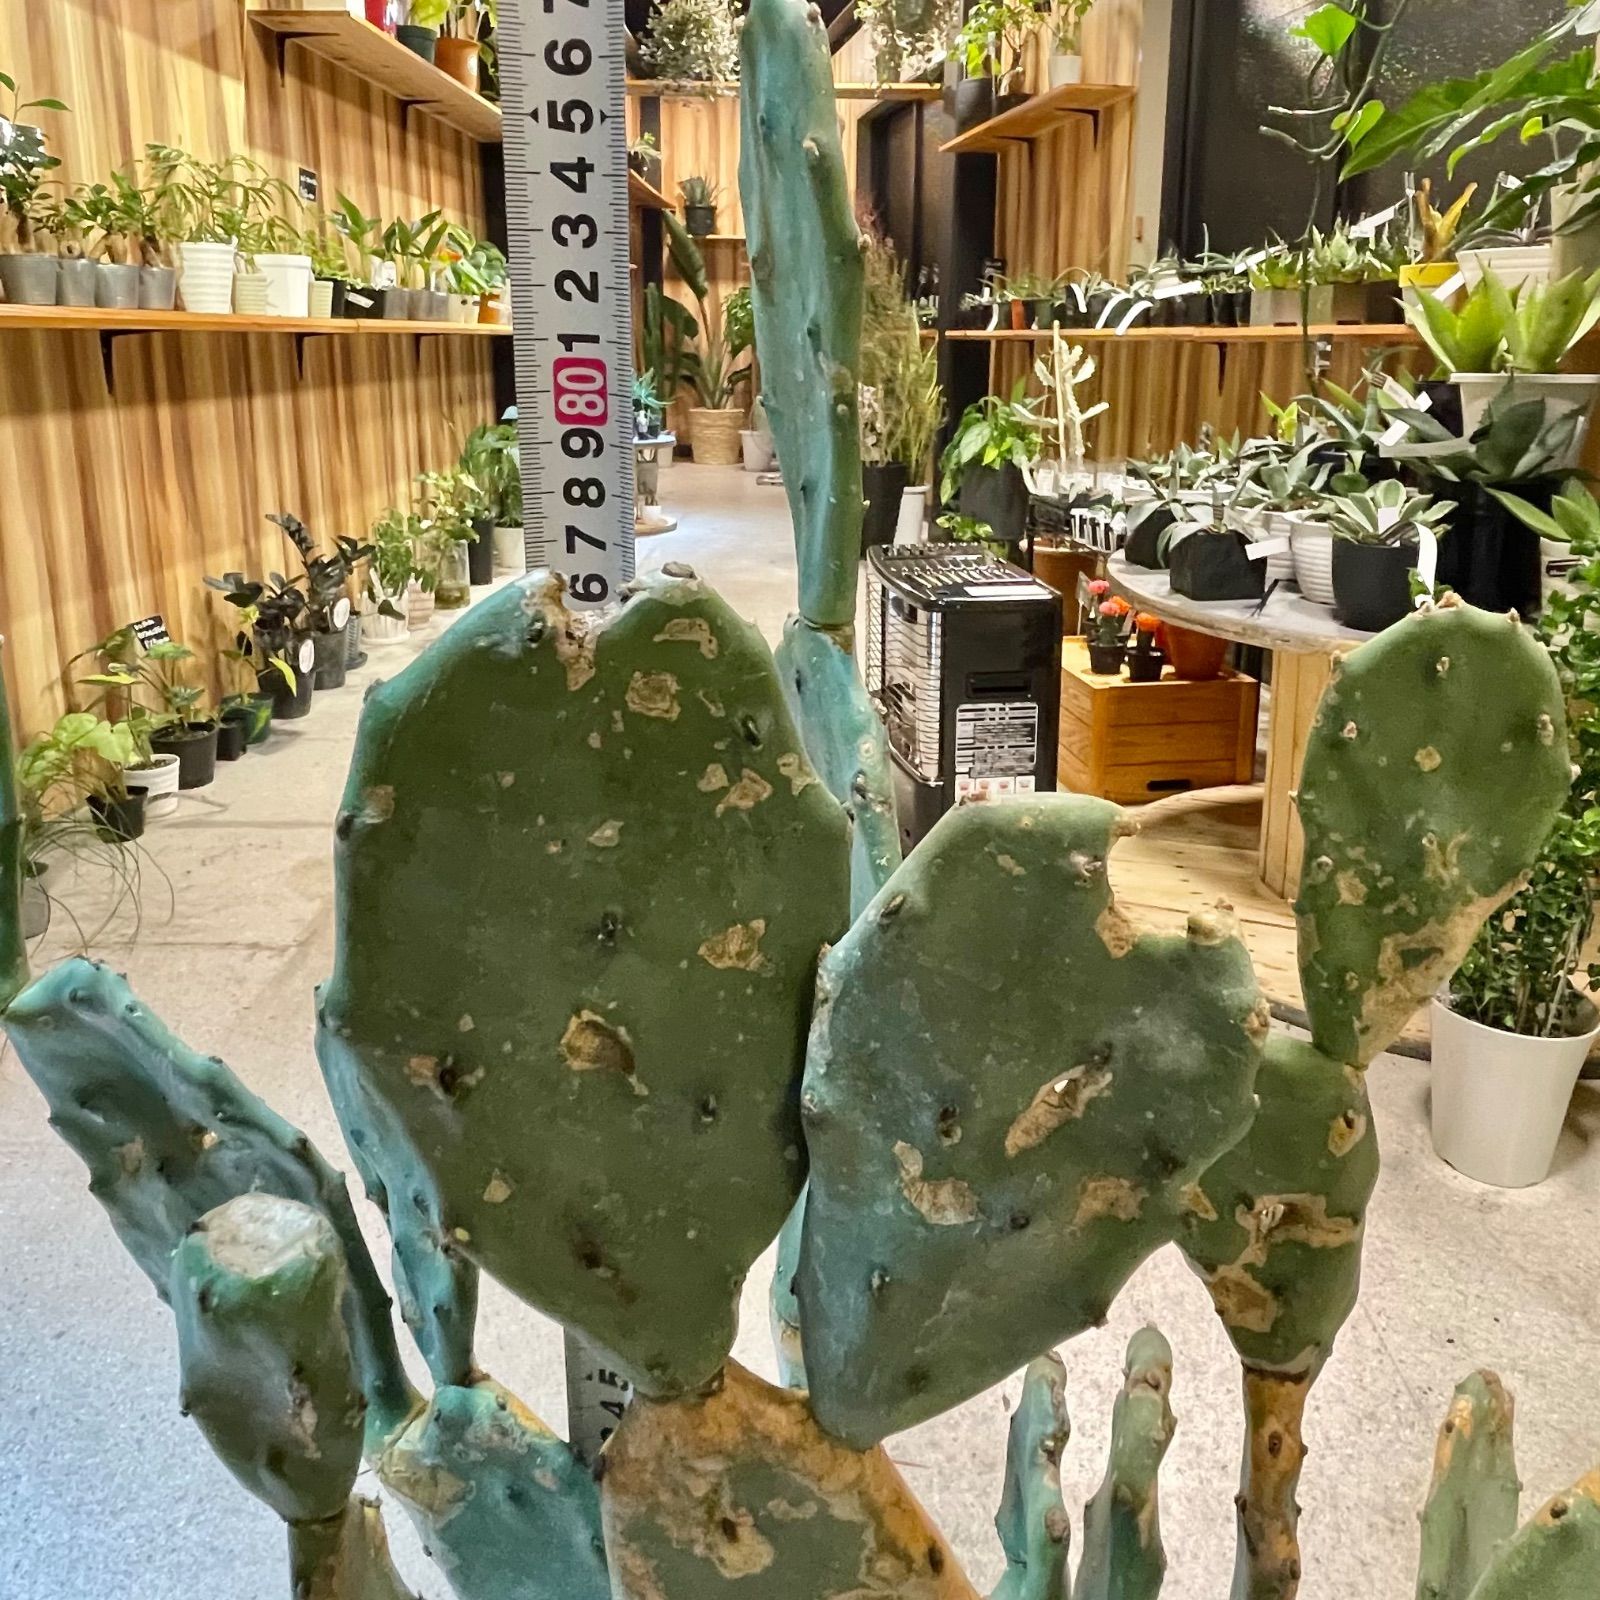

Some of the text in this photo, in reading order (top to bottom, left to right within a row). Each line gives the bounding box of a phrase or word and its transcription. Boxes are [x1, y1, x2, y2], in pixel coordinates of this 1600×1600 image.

[543, 38, 592, 77] 6
[546, 98, 595, 135] 5
[549, 156, 595, 194] 4
[551, 213, 598, 249] 3
[554, 269, 600, 304] 2
[556, 333, 601, 353] 1
[556, 366, 605, 417] 80
[560, 427, 605, 459] 9
[562, 477, 606, 509] 8
[564, 524, 607, 555] 7
[568, 573, 609, 603] 6
